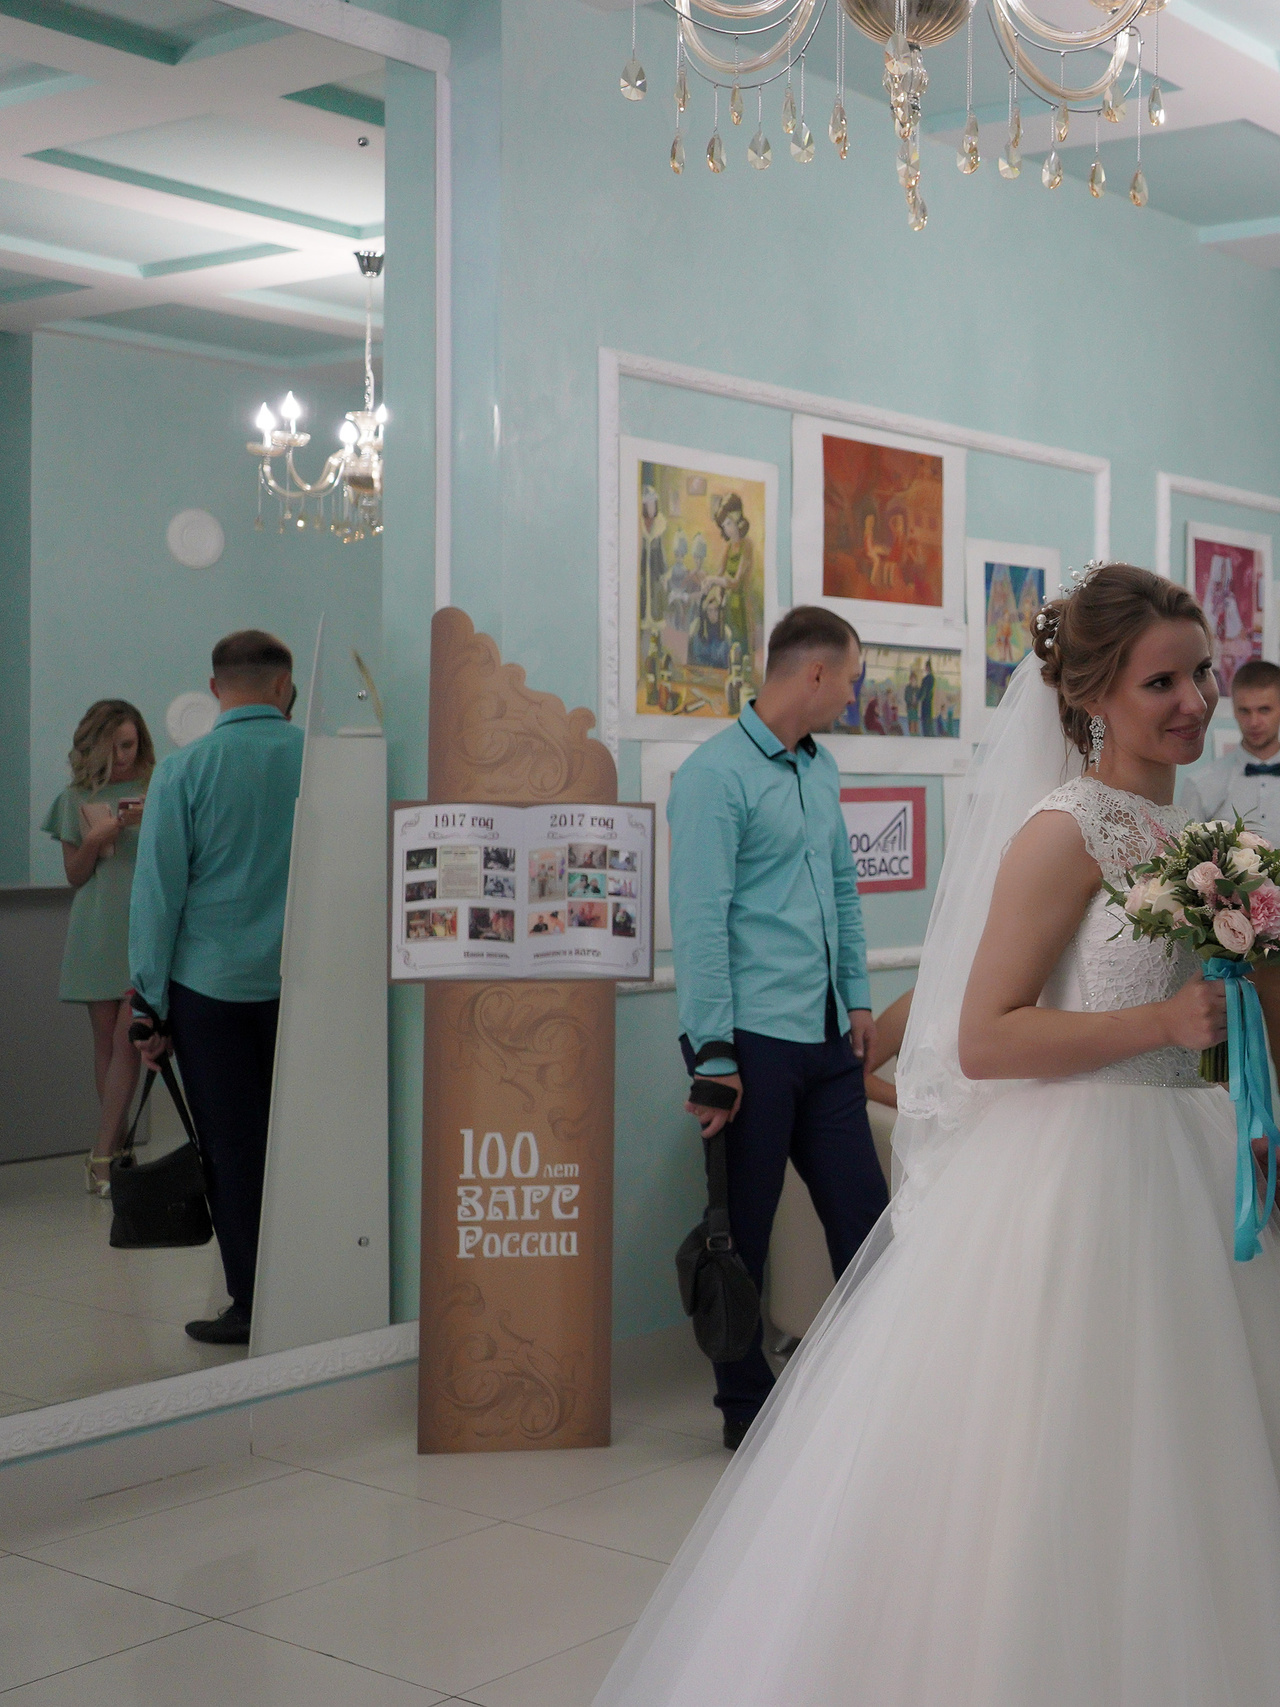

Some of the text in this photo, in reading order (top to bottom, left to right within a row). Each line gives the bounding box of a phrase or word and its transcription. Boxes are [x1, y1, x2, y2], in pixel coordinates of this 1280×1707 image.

[434, 814, 494, 830] 1917 год
[550, 814, 614, 830] 2017 год
[850, 834, 869, 853] 00
[857, 856, 909, 877] ЗБАСС
[459, 1128, 579, 1180] 100 лет
[457, 1184, 580, 1221] ЗАГС
[456, 1226, 579, 1258] России
